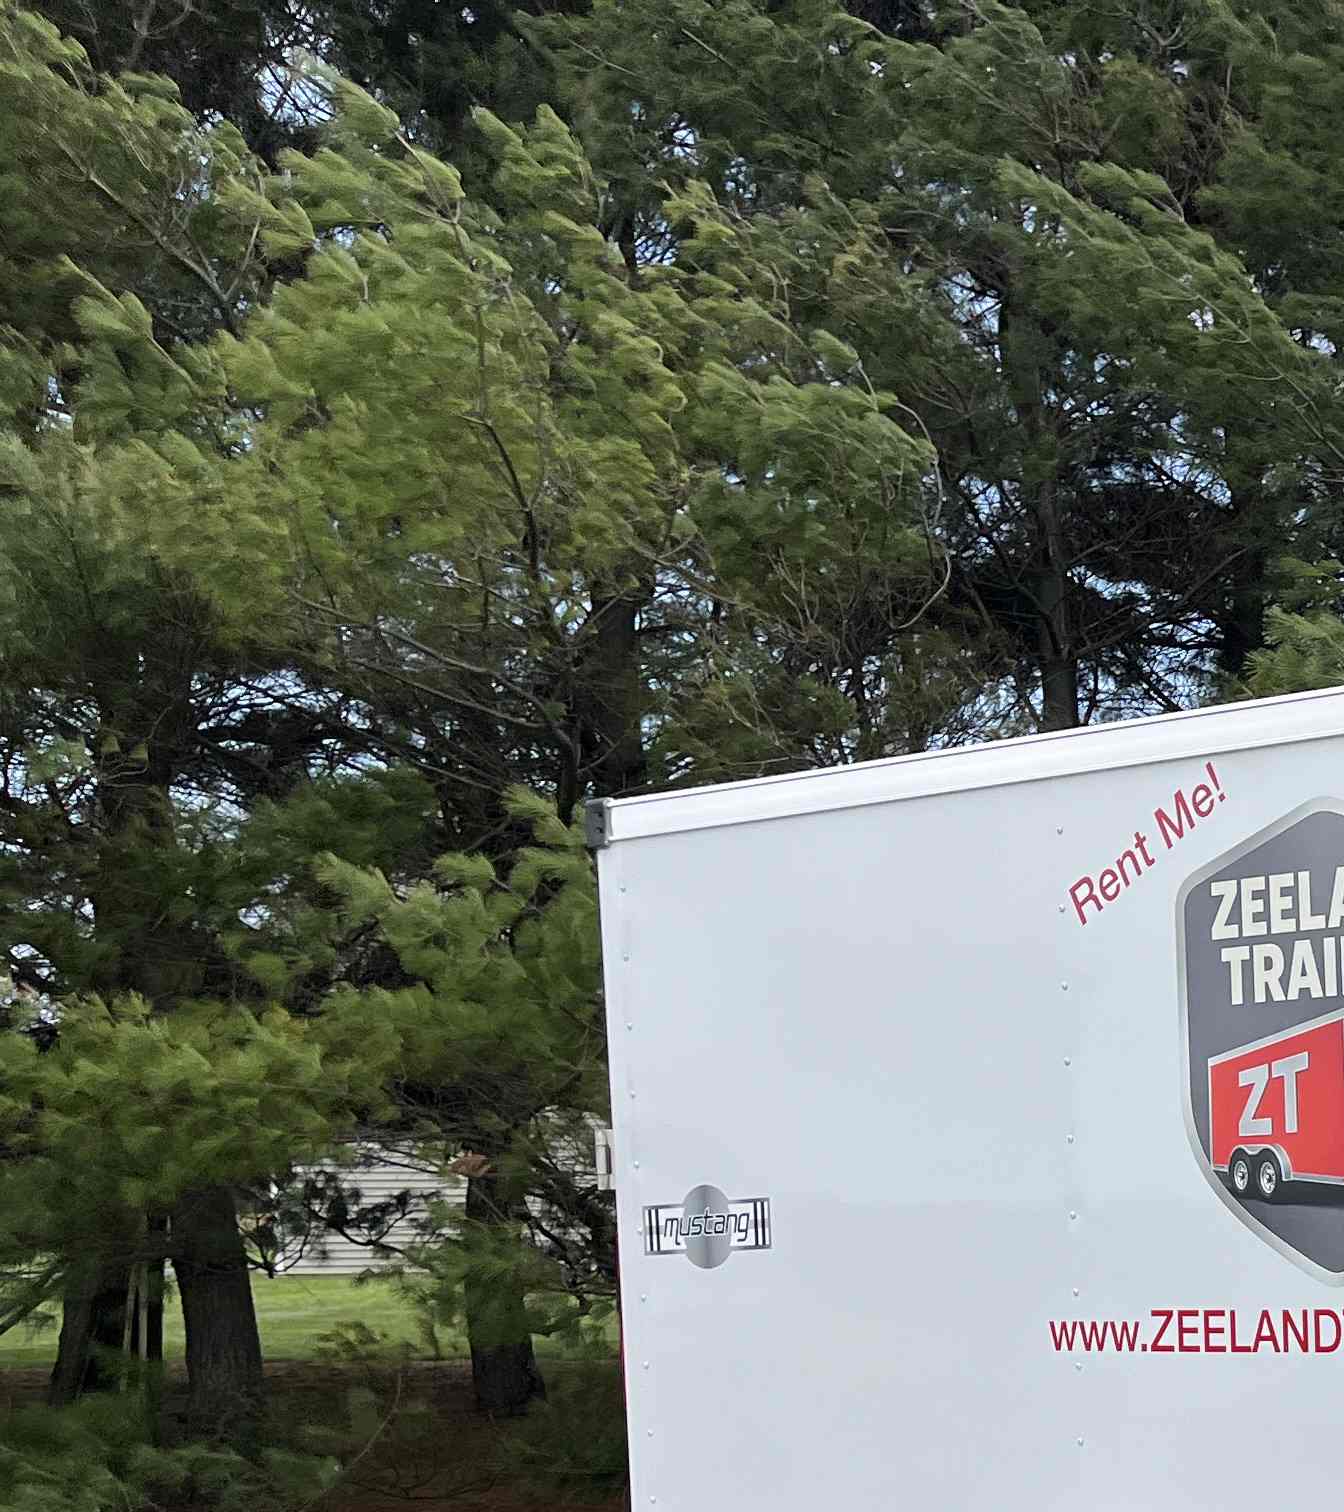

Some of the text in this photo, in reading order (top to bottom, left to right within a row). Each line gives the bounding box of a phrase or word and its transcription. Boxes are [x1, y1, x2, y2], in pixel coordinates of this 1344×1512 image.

[1069, 762, 1226, 925] Rent Me!
[1239, 1051, 1309, 1136] ZT
[664, 1208, 749, 1245] mustang
